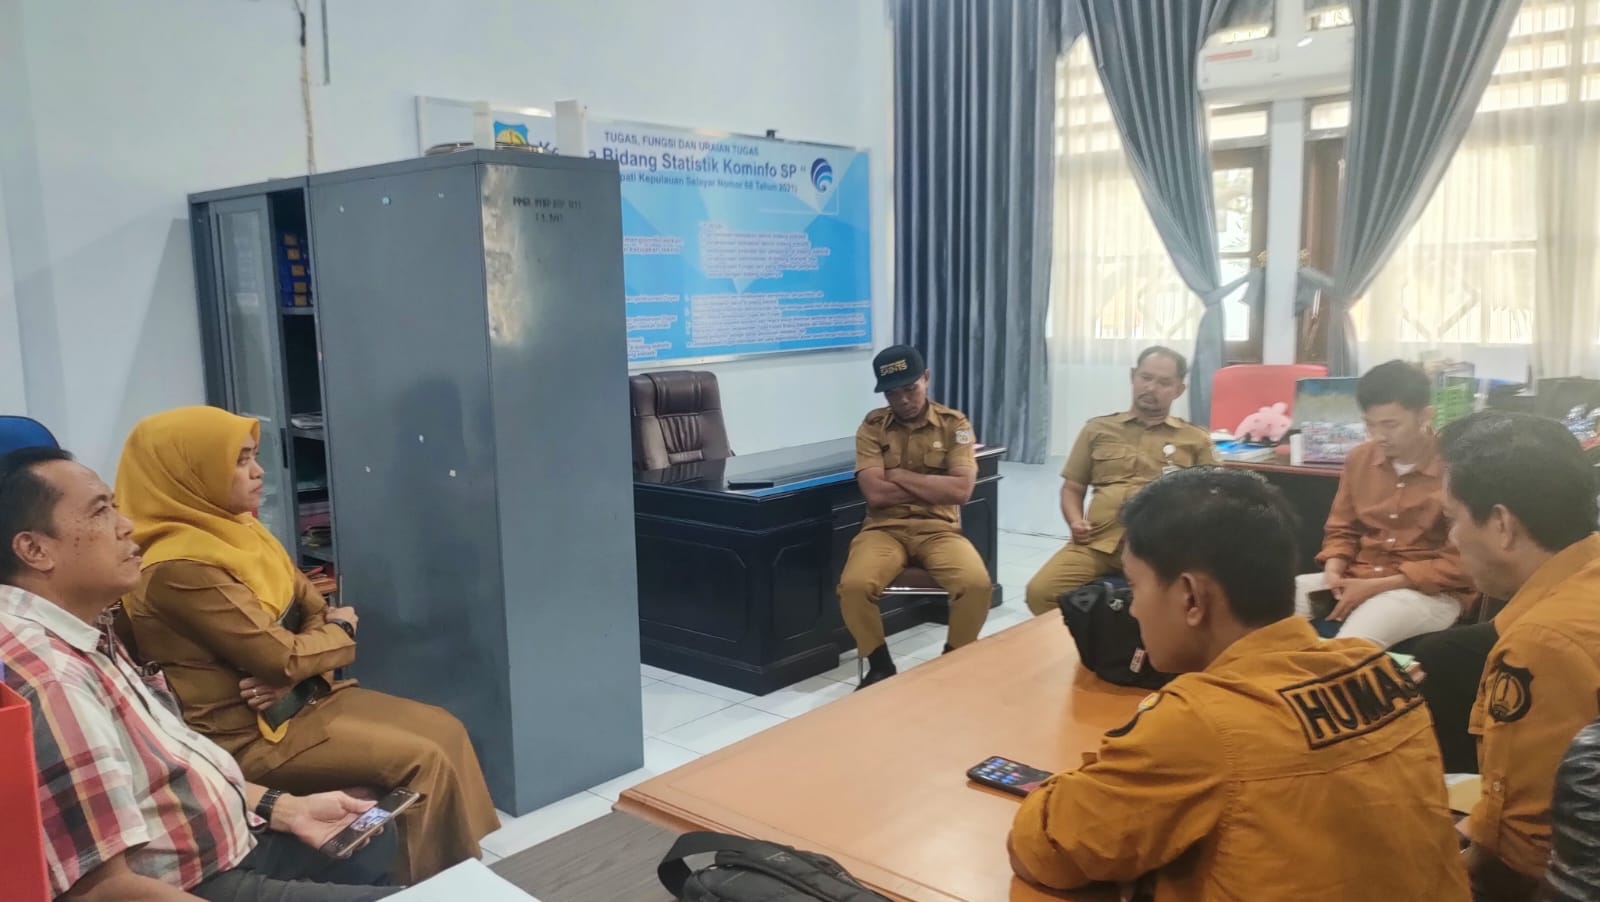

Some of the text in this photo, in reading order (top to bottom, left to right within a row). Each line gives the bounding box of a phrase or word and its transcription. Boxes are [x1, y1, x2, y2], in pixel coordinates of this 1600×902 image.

[642, 136, 676, 148] FUNGSI
[679, 139, 697, 150] DAN
[700, 140, 730, 153] URAIAN
[733, 144, 759, 156] TUGAS
[602, 147, 657, 172] Bidang
[662, 152, 719, 173] Statistik
[723, 159, 777, 178] Kominfo
[780, 163, 797, 179] SP
[640, 173, 684, 185] Kepulauan
